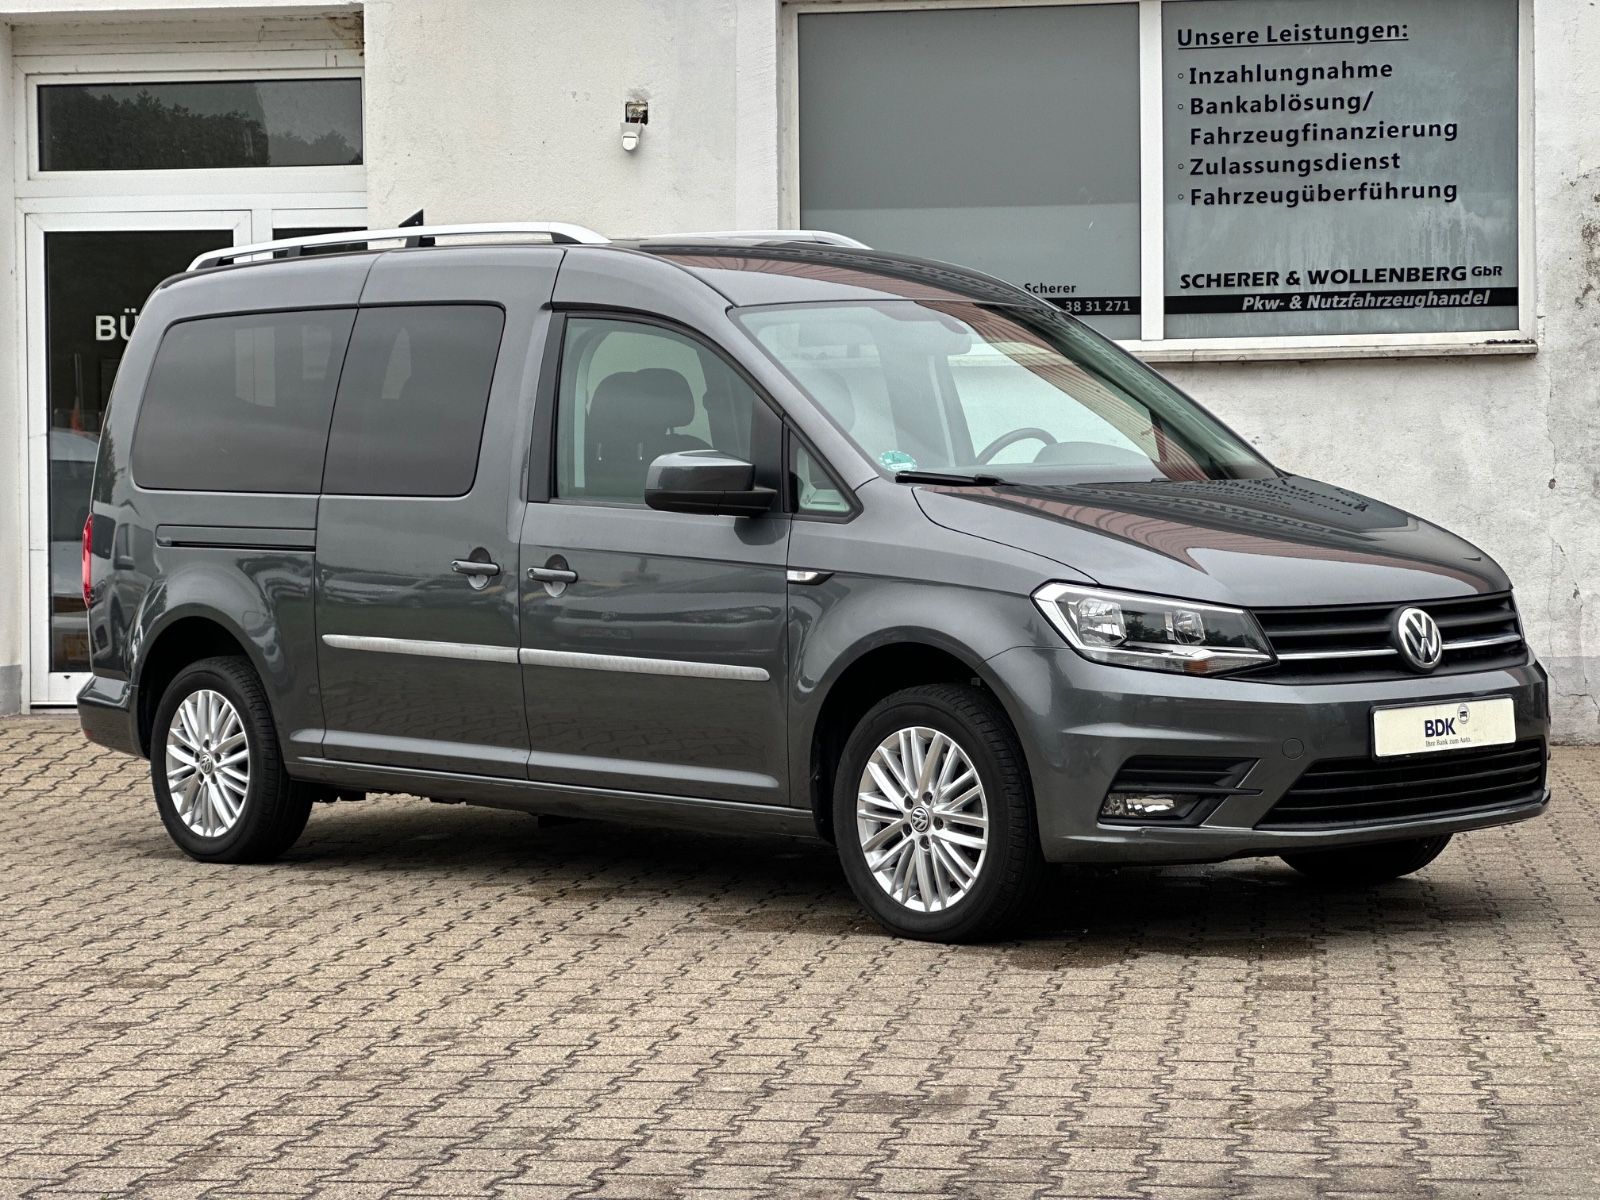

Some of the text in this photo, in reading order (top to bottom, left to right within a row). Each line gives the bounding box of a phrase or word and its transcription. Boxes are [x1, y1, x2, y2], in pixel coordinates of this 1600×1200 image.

[1177, 22, 1409, 47] Unsere Leistungen:
[1189, 61, 1393, 85] Inzahlungnahme
[1190, 91, 1374, 115] Bankablösung/
[1190, 120, 1459, 146] Fahrzeugfinanzierung
[1189, 152, 1401, 177] Zulassungsdienst
[1190, 181, 1458, 207] Fahrzeugüberführung
[1024, 282, 1077, 294] Scherer
[1180, 265, 1503, 289] SCHERER & WOLLENBERG GbR
[1065, 300, 1131, 312] 38 31 271
[1242, 289, 1491, 311] Pkw- & Nutzfahrzeughandel
[1424, 717, 1456, 738] BDK
